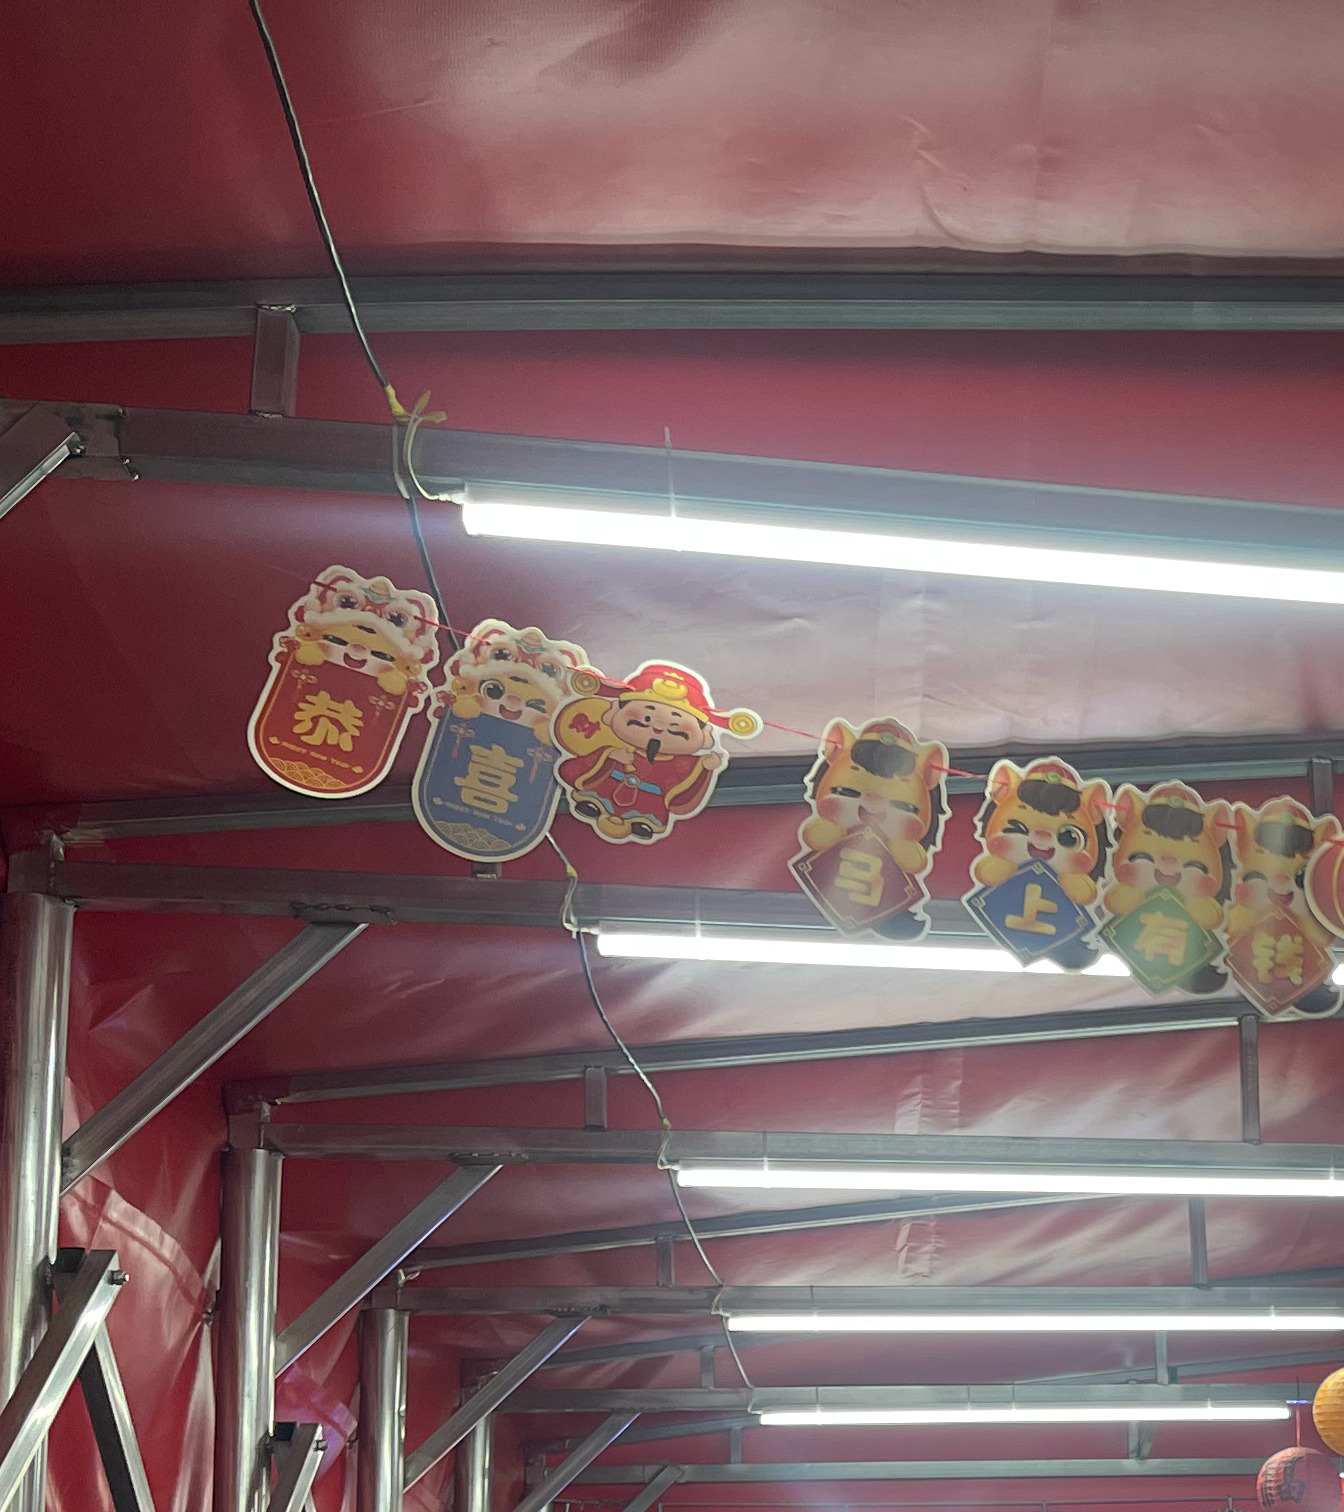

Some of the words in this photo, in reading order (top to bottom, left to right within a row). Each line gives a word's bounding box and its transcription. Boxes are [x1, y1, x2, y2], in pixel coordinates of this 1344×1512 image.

[293, 691, 363, 751] 恭
[454, 744, 525, 814] 喜
[1005, 885, 1059, 936] 上
[1134, 912, 1190, 965] 有
